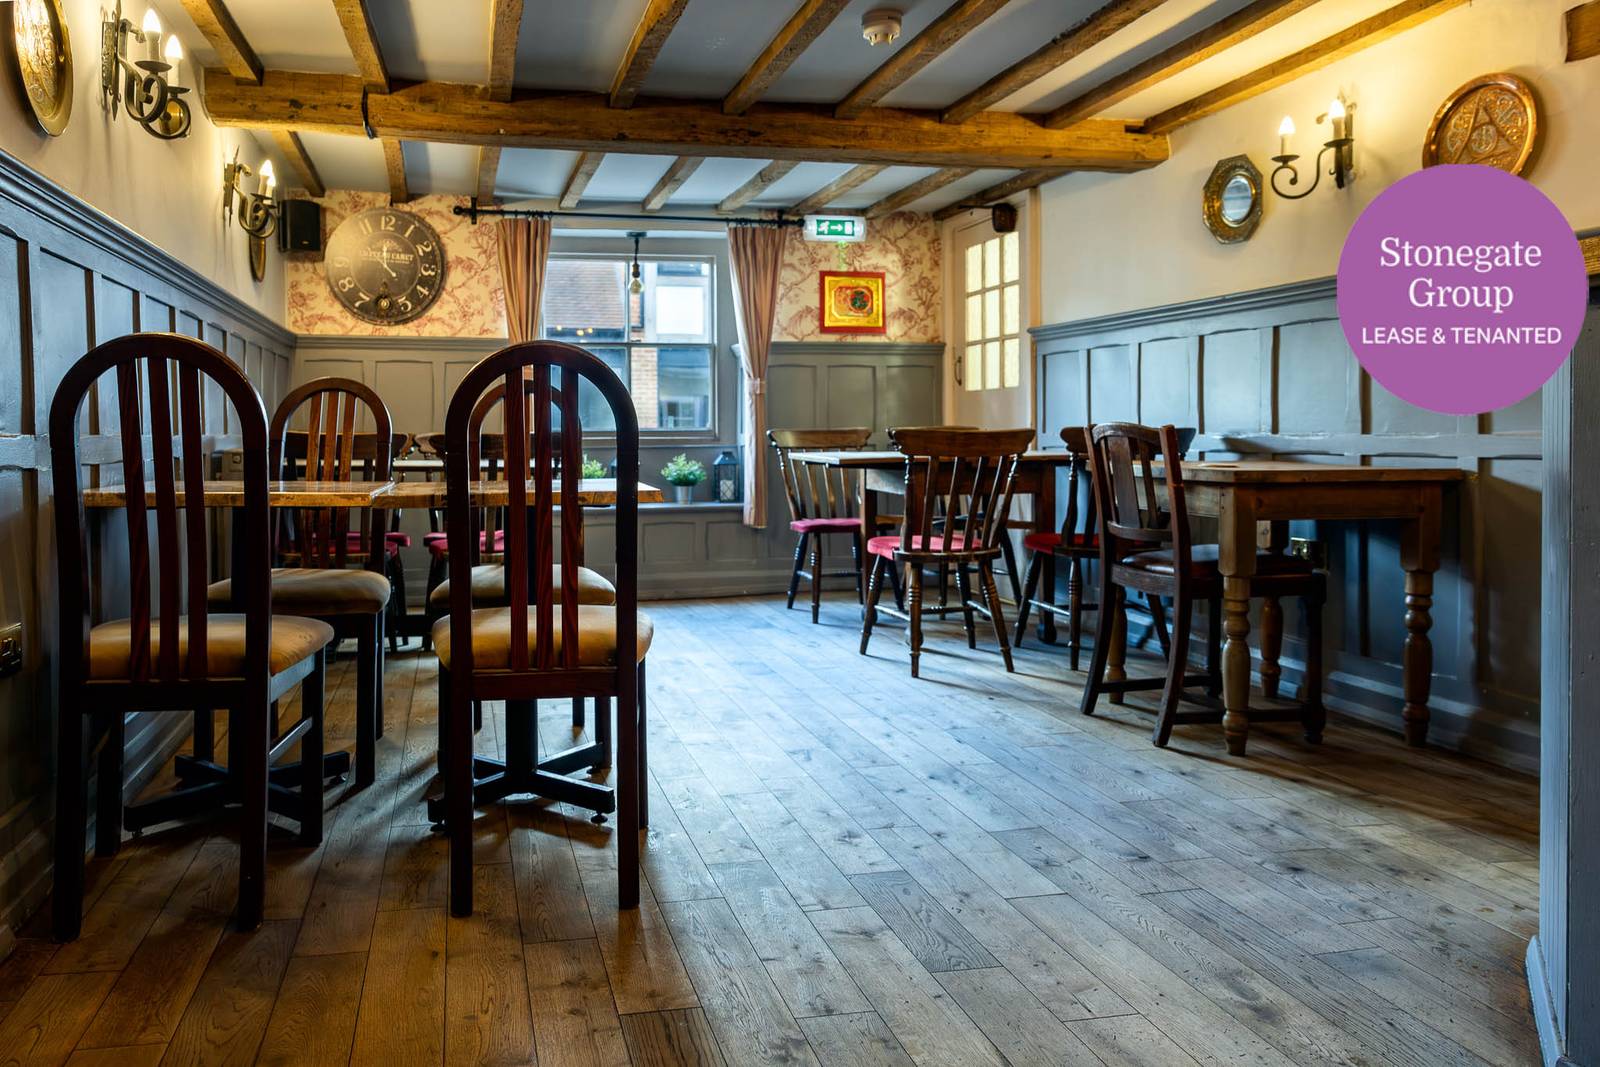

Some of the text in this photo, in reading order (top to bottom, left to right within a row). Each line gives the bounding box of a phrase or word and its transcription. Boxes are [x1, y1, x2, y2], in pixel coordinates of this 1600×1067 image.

[360, 218, 373, 235] 11
[381, 215, 396, 231] 12
[404, 224, 415, 238] 1
[416, 241, 432, 256] 2
[421, 264, 437, 277] 3
[338, 277, 355, 292] 8
[416, 284, 430, 299] 4
[354, 292, 371, 308] 7
[397, 295, 412, 312] 5
